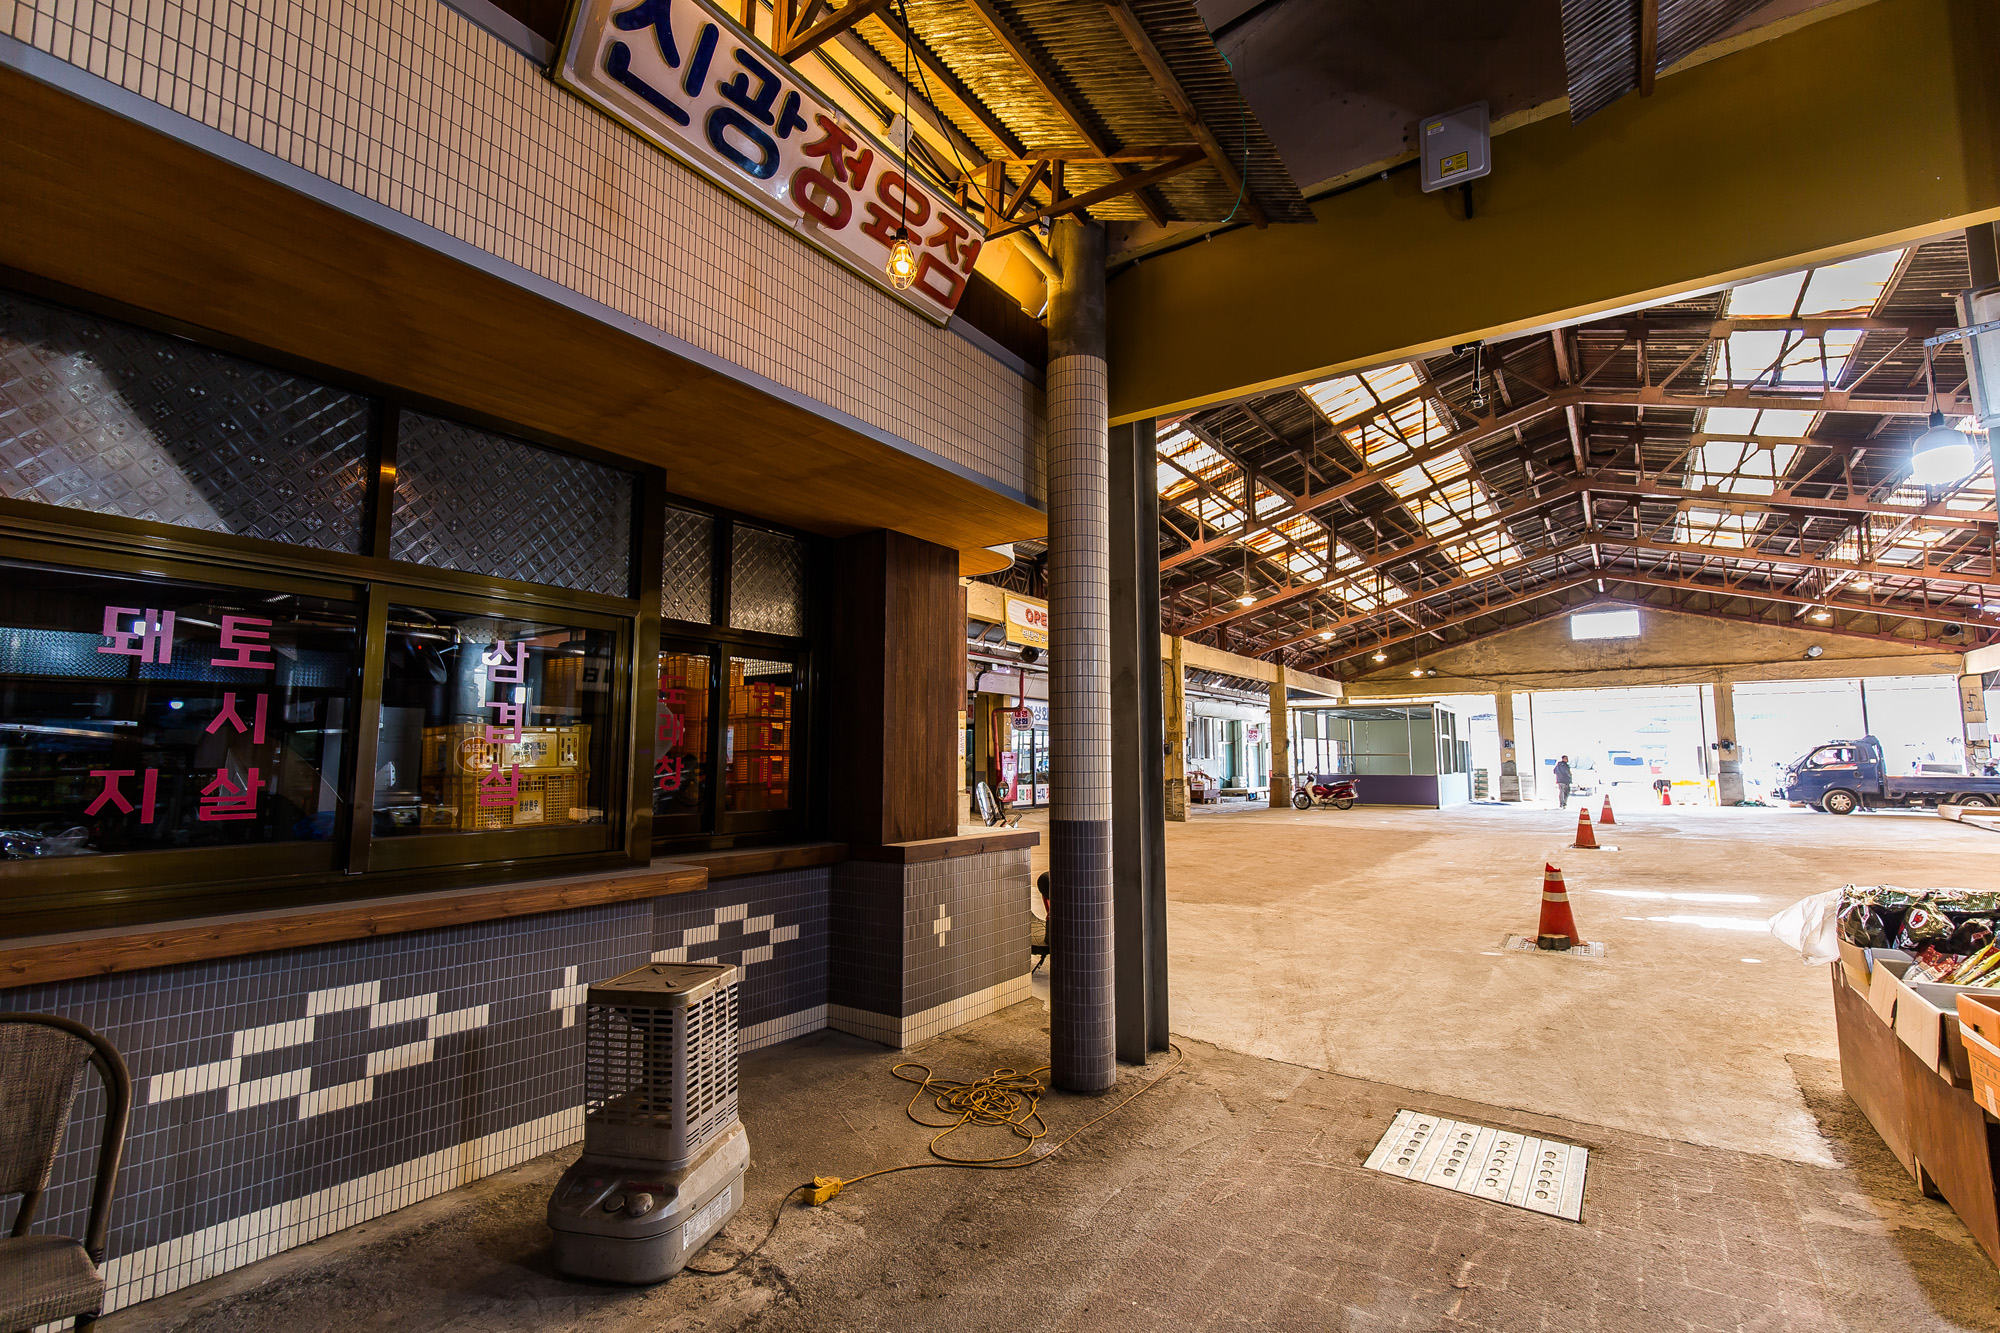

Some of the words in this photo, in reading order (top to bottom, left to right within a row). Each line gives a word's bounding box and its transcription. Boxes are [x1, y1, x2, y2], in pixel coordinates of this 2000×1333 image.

[84, 606, 176, 824] 돼지
[200, 615, 275, 821] 토시살
[480, 640, 530, 806] 삼겹살
[656, 675, 687, 791] 도래창
